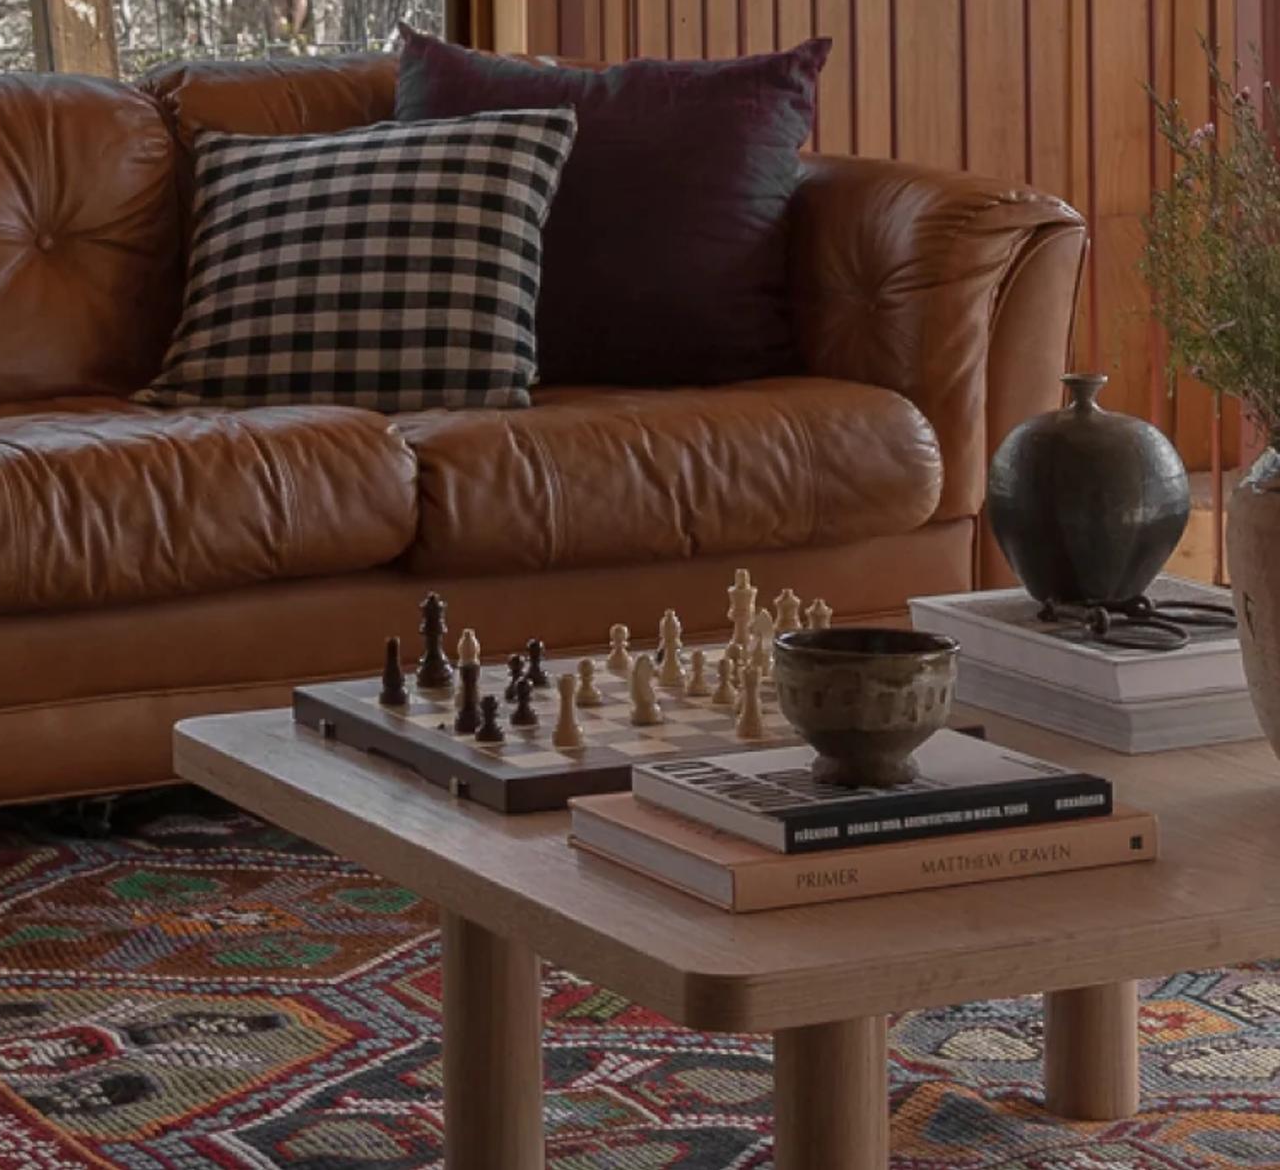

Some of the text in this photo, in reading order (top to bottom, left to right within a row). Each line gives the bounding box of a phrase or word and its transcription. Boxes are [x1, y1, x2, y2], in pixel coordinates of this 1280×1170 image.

[796, 844, 1072, 889] PRIMER MATTHEW CRAVEN
